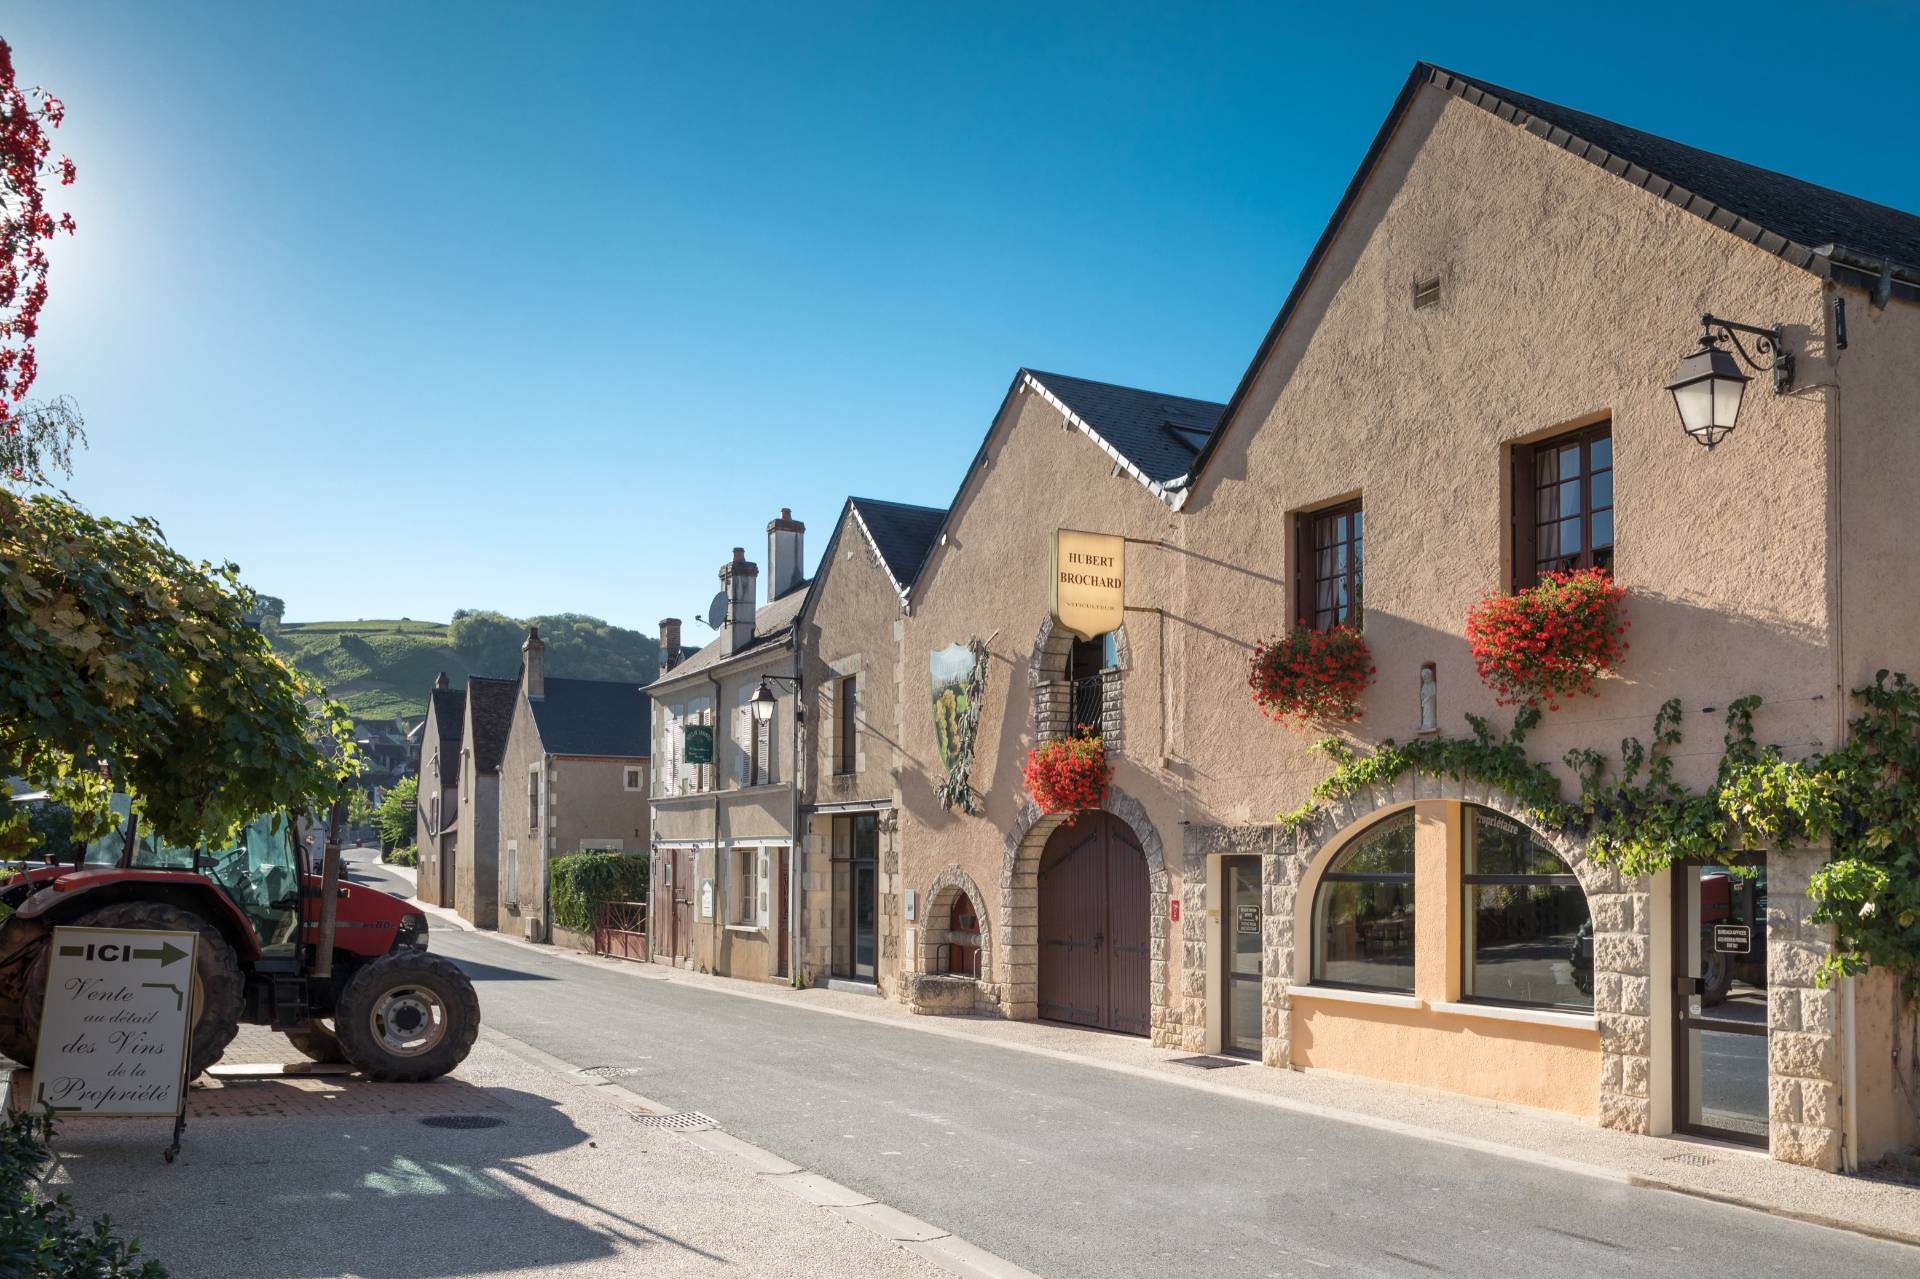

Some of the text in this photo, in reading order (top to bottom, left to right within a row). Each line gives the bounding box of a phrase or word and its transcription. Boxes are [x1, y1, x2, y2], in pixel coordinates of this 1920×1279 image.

[1069, 553, 1115, 567] HUBERT
[1060, 571, 1122, 589] BROCHARD
[1475, 812, 1519, 836] Propriétaire
[86, 944, 131, 962] ICI
[64, 977, 135, 1001] Vente
[83, 1009, 159, 1024] au détail
[61, 1031, 165, 1054] des Vins
[107, 1062, 147, 1077] de la
[49, 1076, 171, 1109] Propriété
